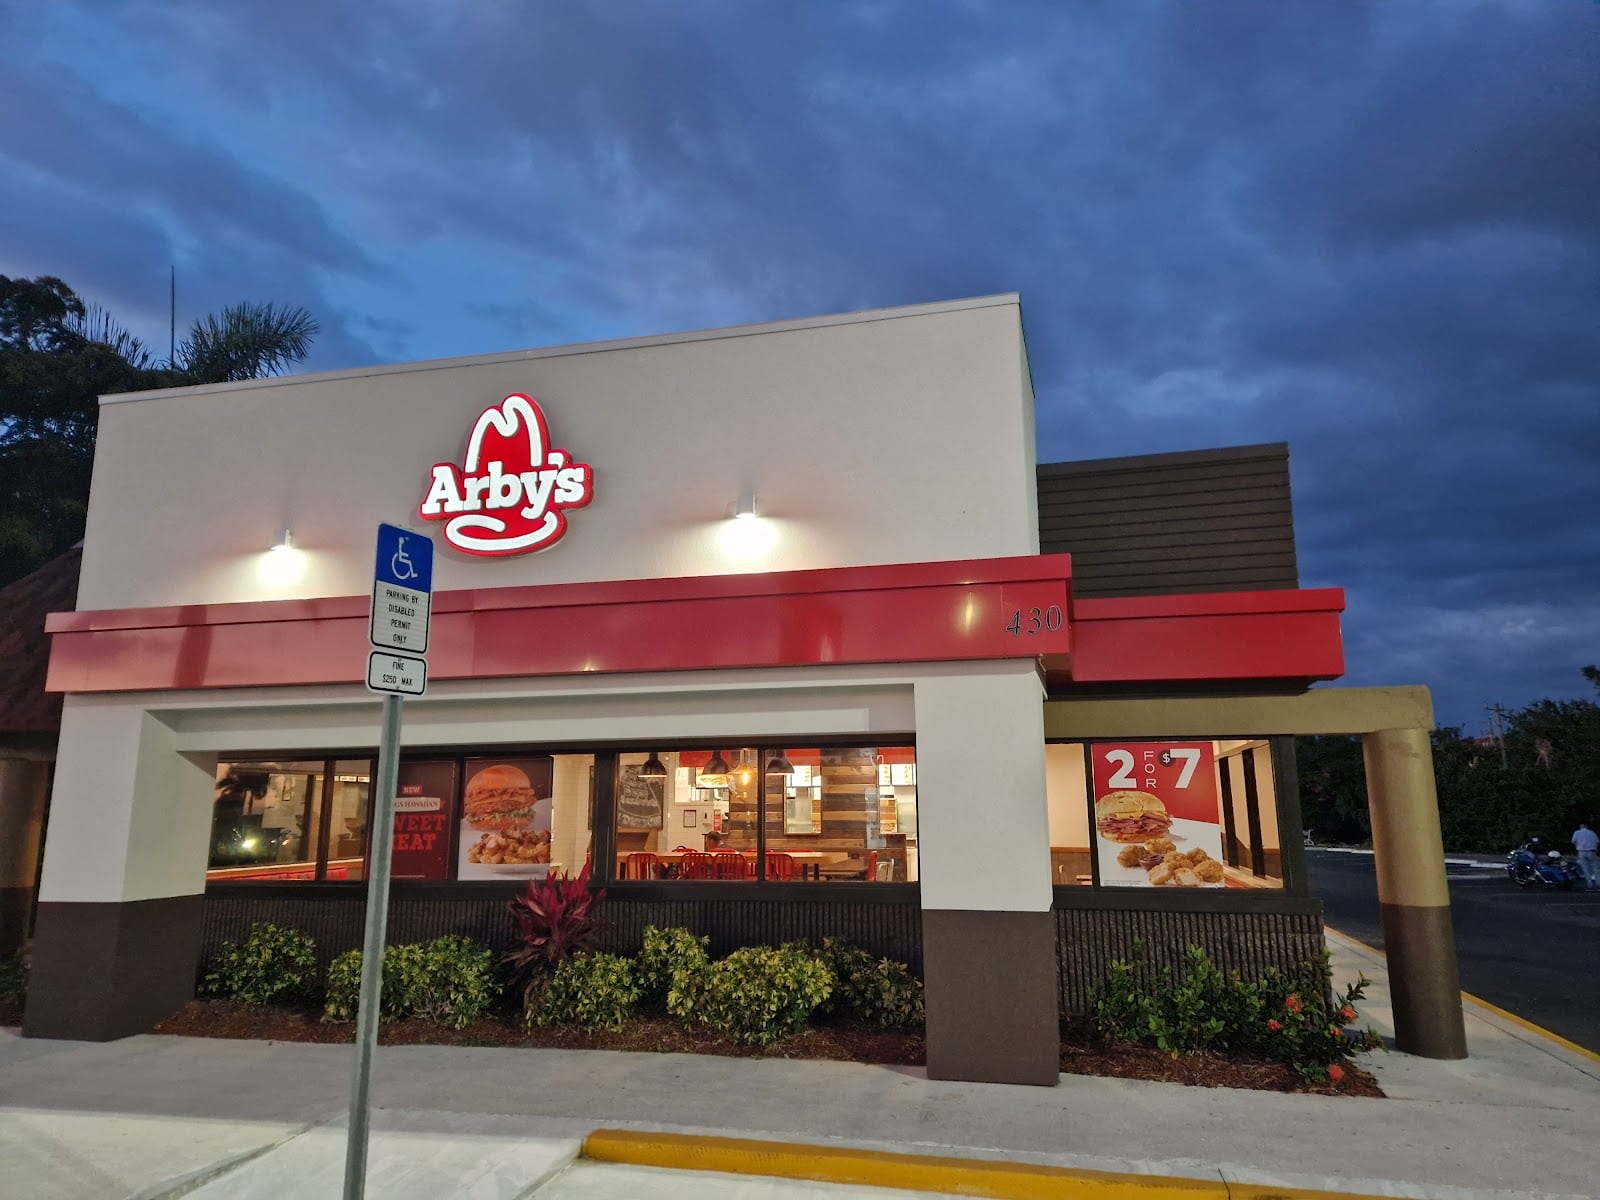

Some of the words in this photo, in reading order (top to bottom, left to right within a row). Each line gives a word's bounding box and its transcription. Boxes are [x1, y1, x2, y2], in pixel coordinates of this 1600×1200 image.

[421, 452, 585, 519] Arby's
[386, 589, 409, 602] PARKING
[411, 595, 418, 604] BY
[388, 604, 415, 617] DISABLED
[391, 618, 411, 630] PERMIT
[1005, 605, 1062, 637] 430
[393, 633, 406, 644] ONLY
[392, 661, 404, 671] FINE
[382, 674, 396, 684] $250
[401, 677, 413, 686] MAX
[1104, 749, 1137, 788] 2
[1143, 750, 1157, 788] FOR
[1162, 748, 1201, 788] $7
[403, 786, 420, 794] NEW
[391, 833, 436, 850] EAT
